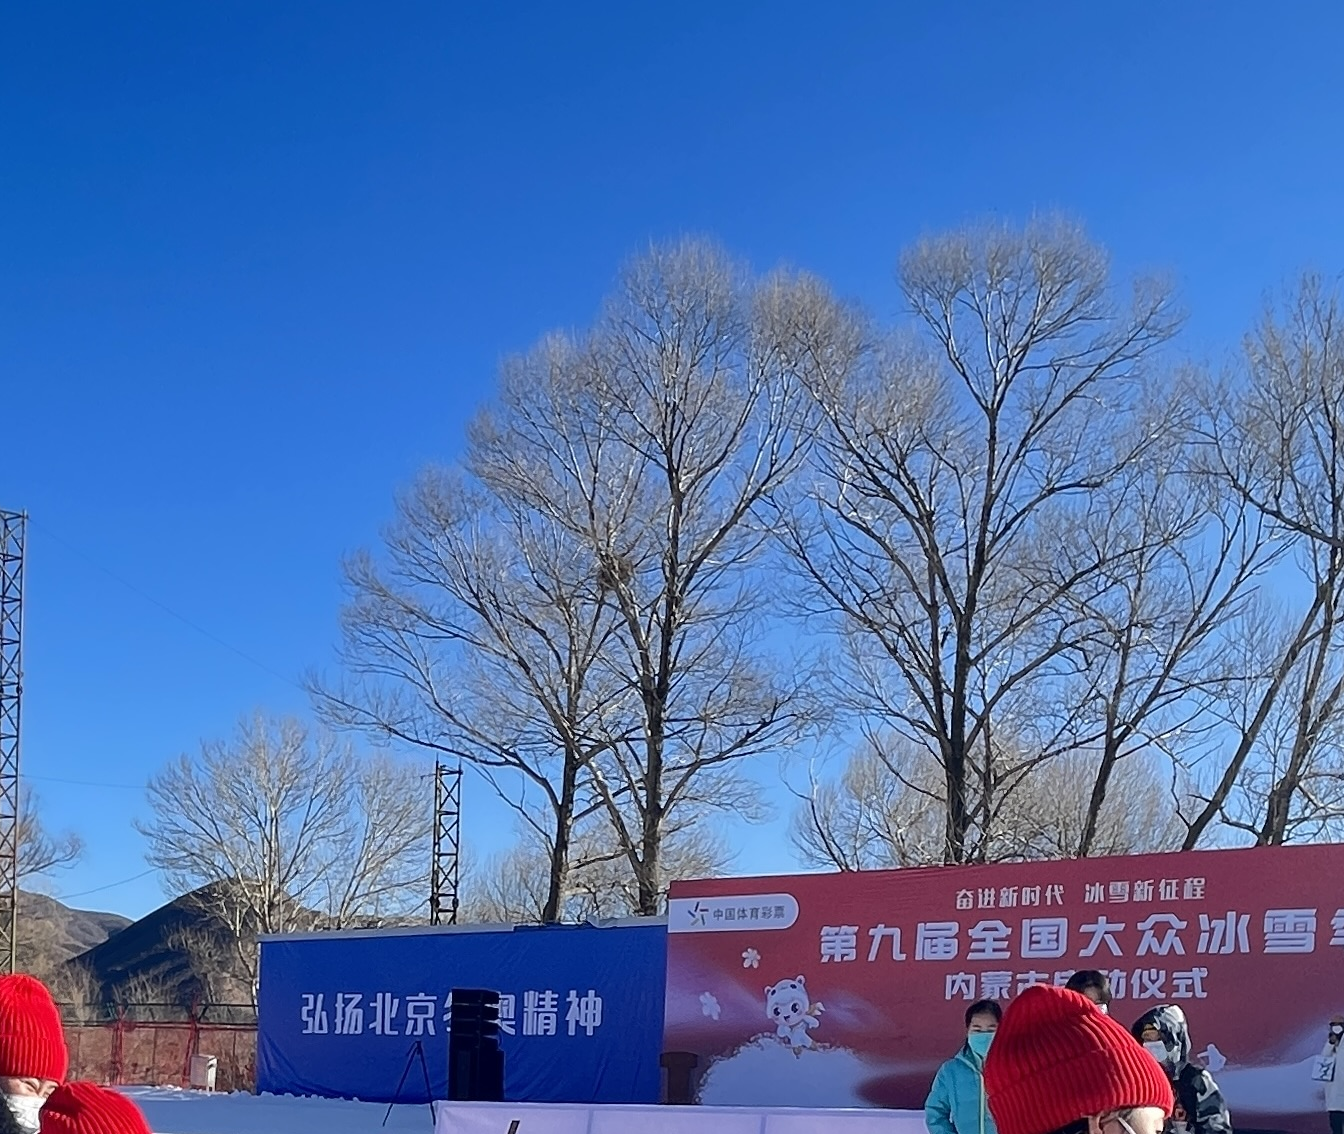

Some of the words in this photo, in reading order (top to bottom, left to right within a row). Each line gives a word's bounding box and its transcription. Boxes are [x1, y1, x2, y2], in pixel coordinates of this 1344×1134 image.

[956, 884, 1064, 910] 奋进新时代
[1084, 877, 1206, 904] 冰雪新征程
[713, 905, 785, 921] 中国体育彩票
[301, 990, 603, 1036] 弘扬北京奥精神
